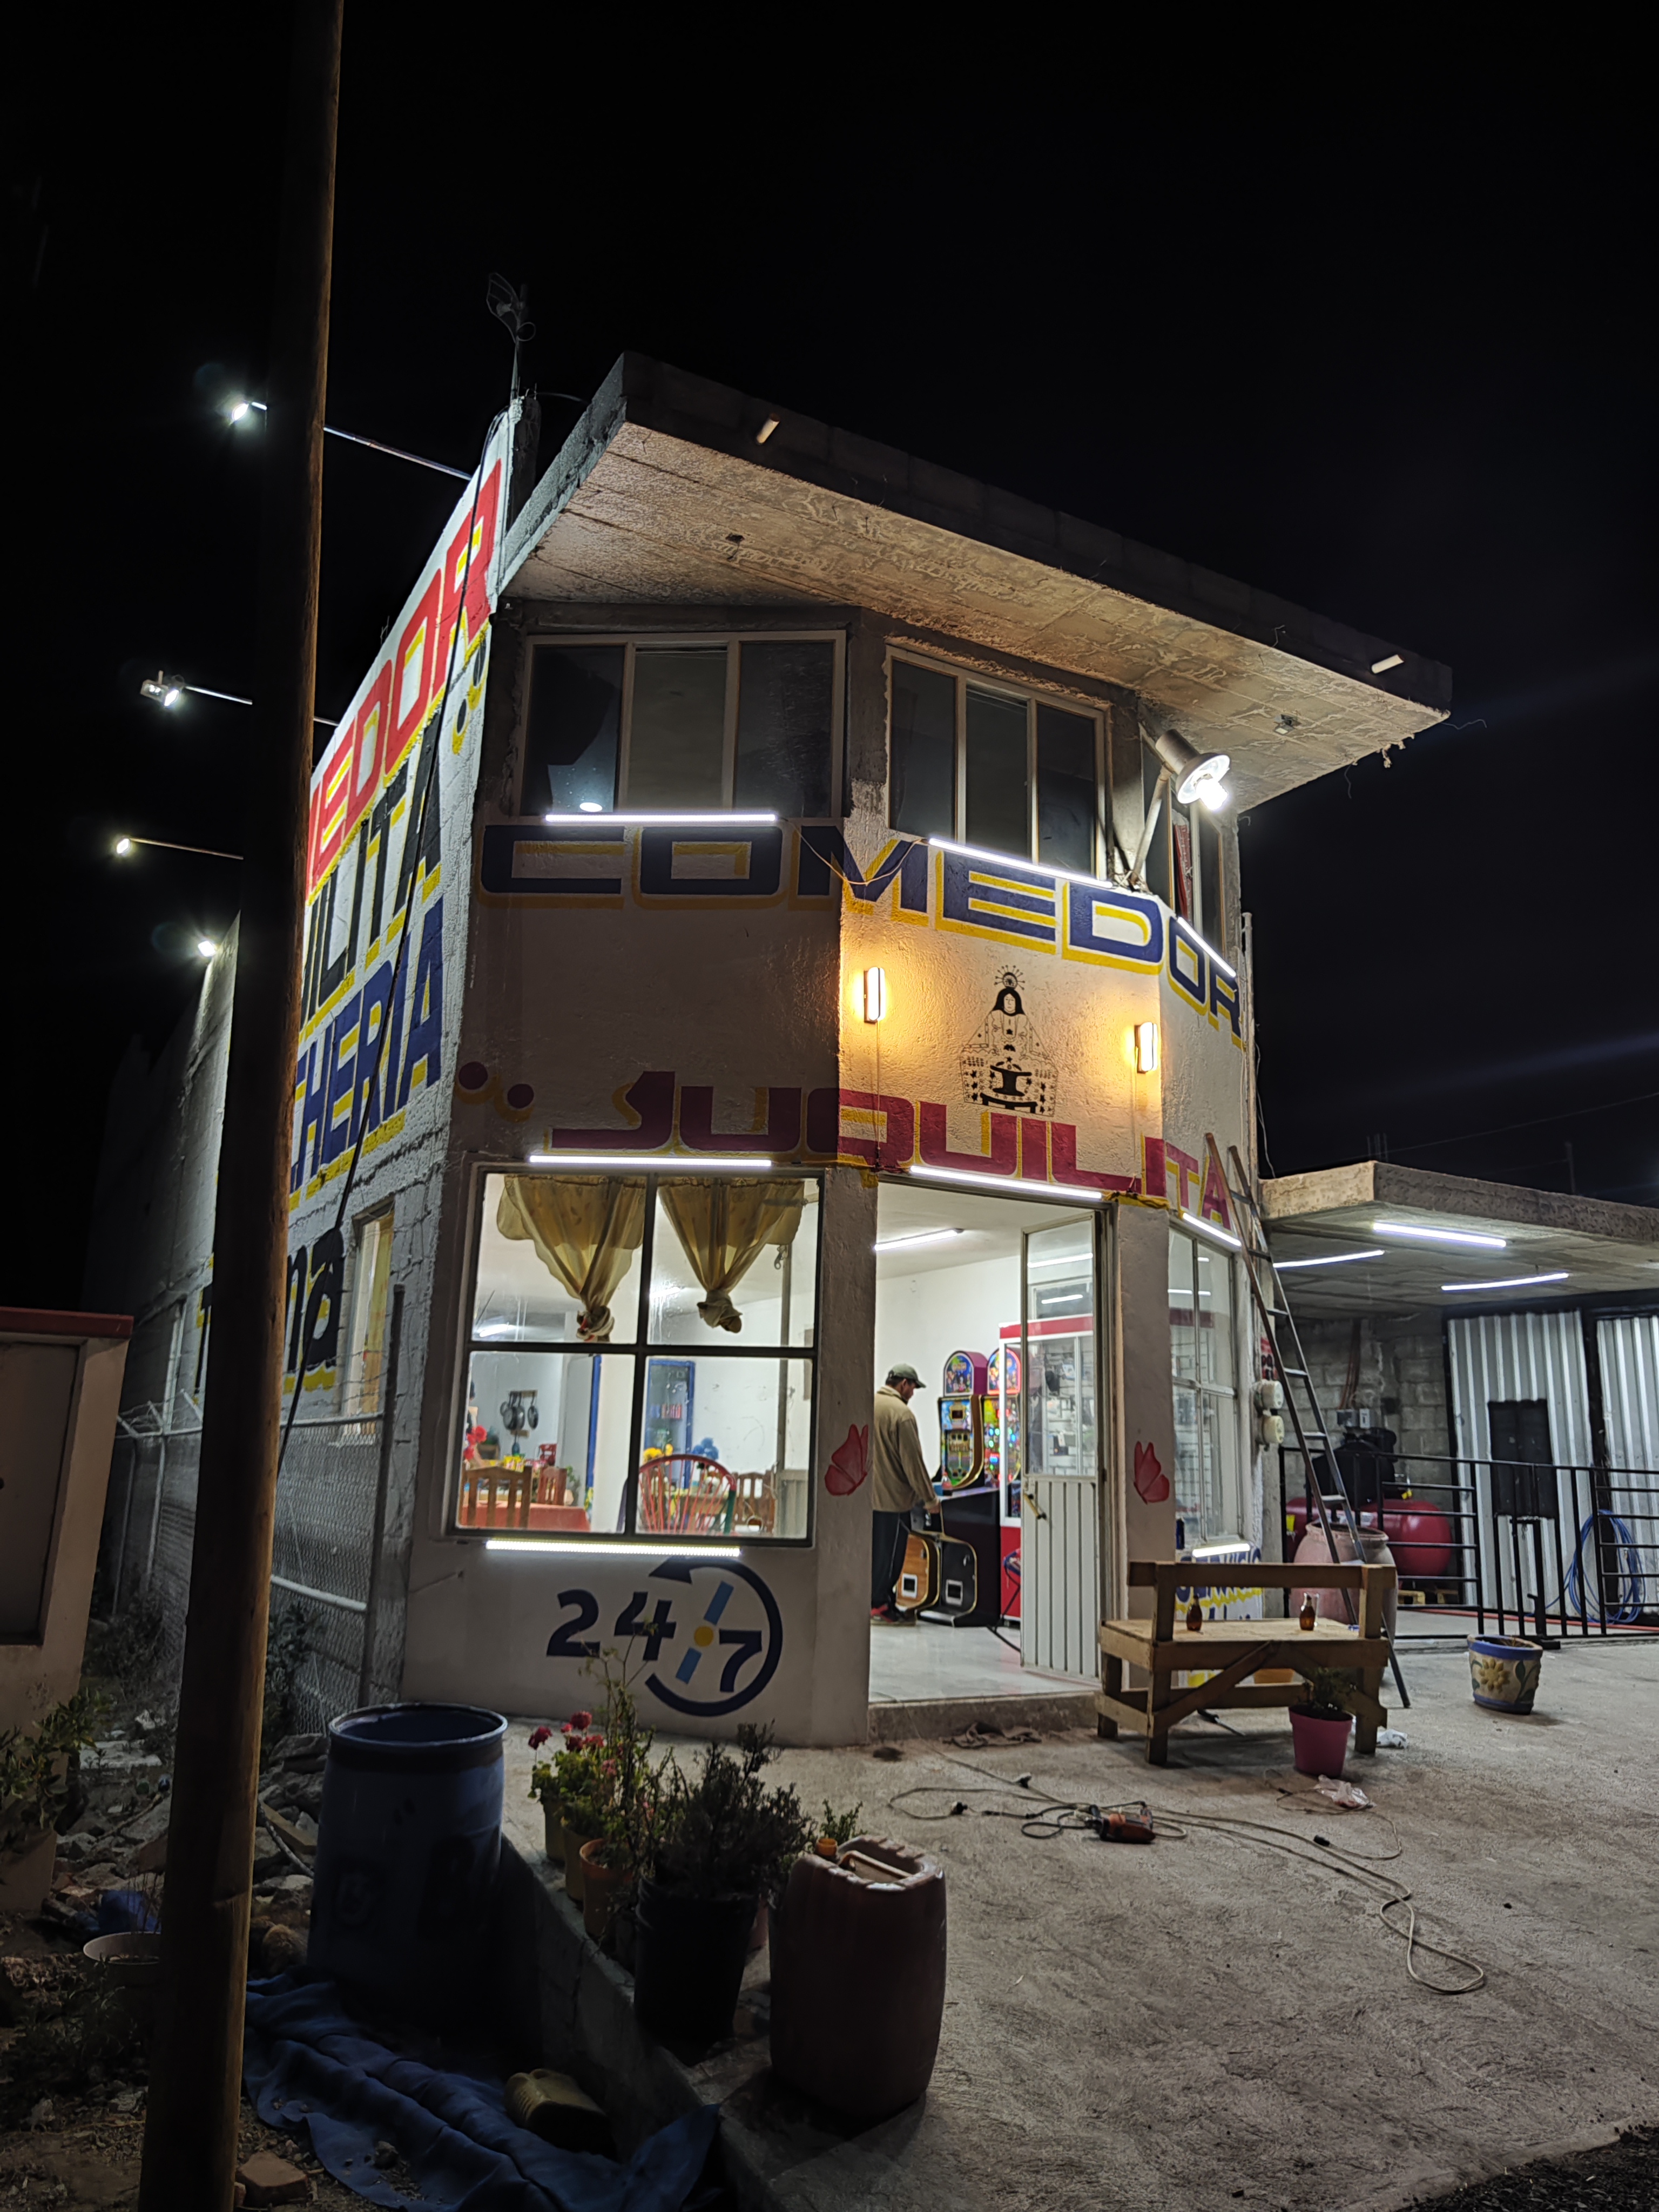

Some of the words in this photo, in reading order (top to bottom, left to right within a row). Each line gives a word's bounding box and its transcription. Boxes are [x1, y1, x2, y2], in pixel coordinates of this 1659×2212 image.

[306, 459, 501, 903] EDOR
[300, 713, 442, 1033] ILITA
[481, 824, 1242, 1040] COMEDOR
[291, 895, 443, 1195] HERIA
[551, 1071, 1232, 1231] JUQUILITA
